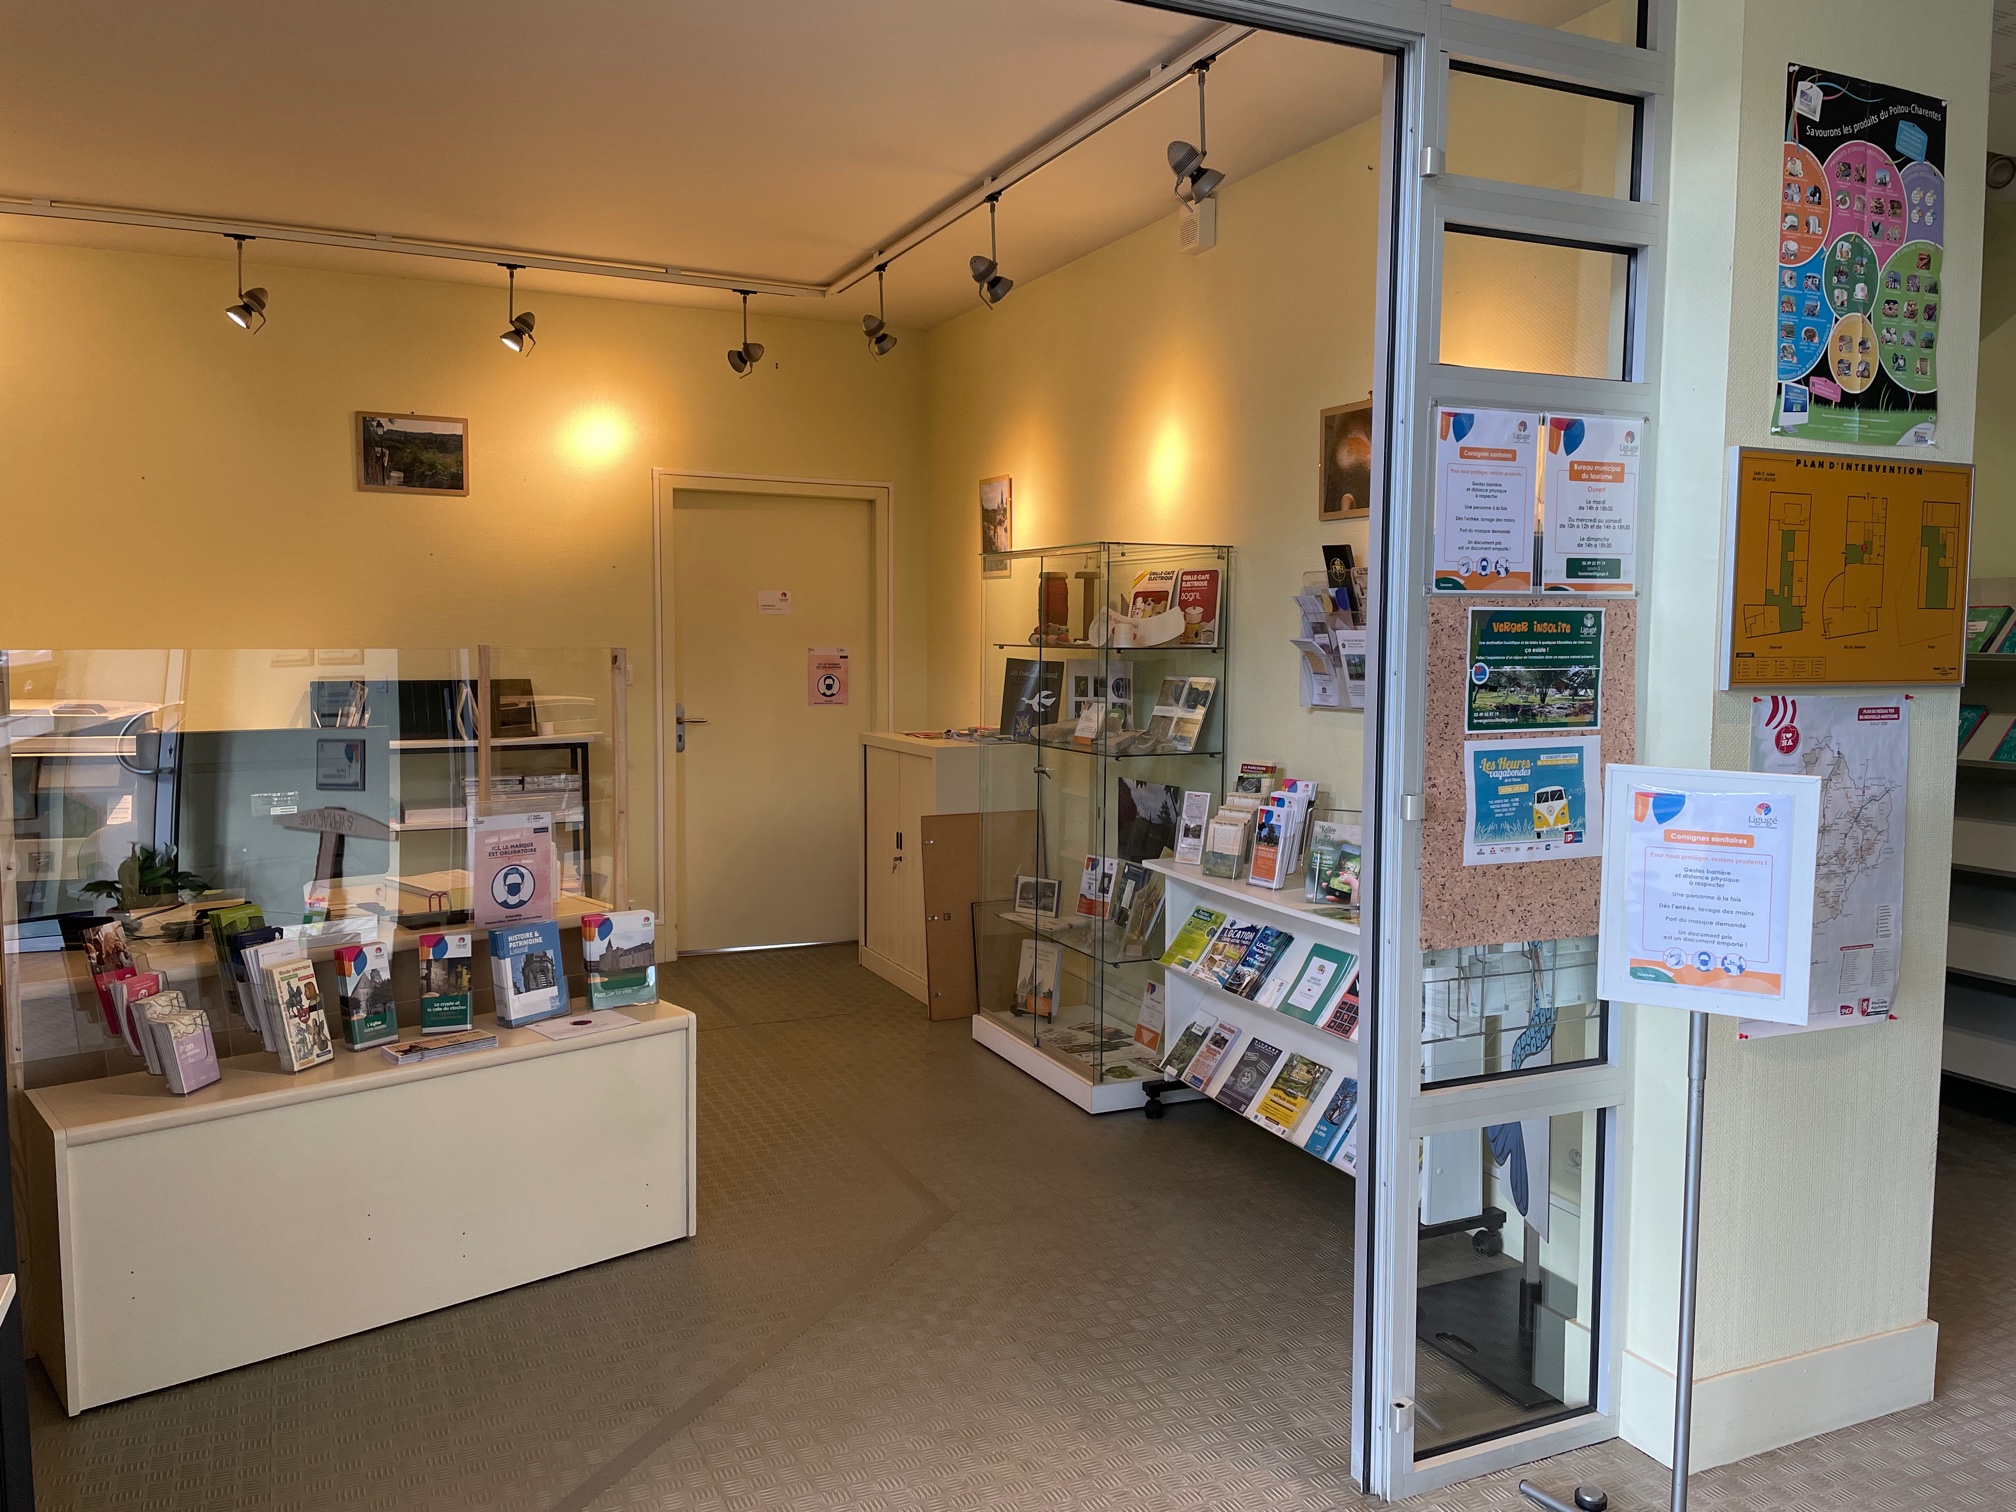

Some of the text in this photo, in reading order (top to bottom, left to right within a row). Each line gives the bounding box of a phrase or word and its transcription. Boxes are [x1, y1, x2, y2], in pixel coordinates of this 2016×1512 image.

[1806, 104, 1942, 137] Savourons les produits du Poitou-Charentes
[1796, 459, 1923, 475] PLAN D'INTERVENTION
[1481, 758, 1496, 774] Les
[1498, 757, 1530, 769] Heures
[1489, 768, 1530, 780] vagabondes
[1748, 815, 1778, 826] Ligugé
[1670, 833, 1748, 845] Consignes sanitaires
[1706, 868, 1731, 876] barrière
[508, 932, 534, 942] HISTOIRE
[1224, 929, 1255, 940] LOCATION
[509, 937, 543, 948] PATRIMOINE
